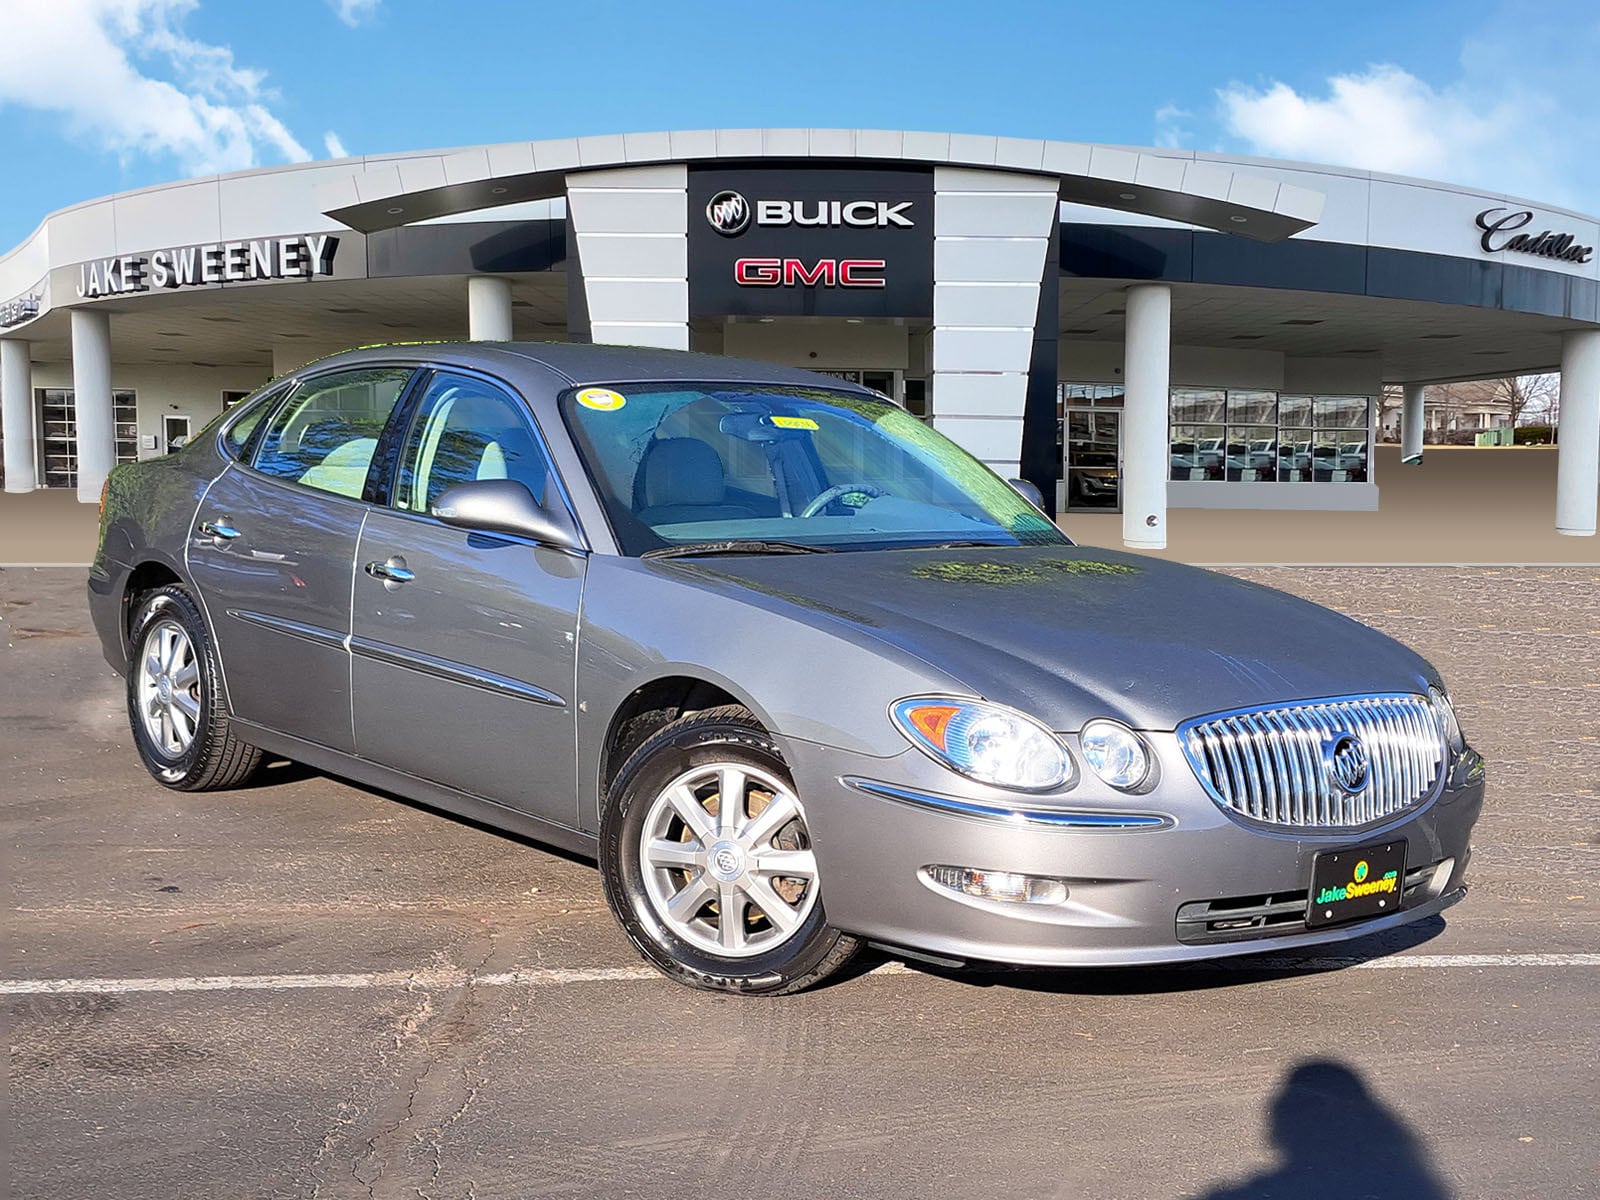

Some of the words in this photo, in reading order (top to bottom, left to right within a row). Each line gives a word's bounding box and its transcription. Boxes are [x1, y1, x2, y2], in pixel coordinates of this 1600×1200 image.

[757, 200, 915, 226] BUICK
[1475, 207, 1593, 264] Cadillac
[76, 255, 147, 298] JAKE
[151, 234, 338, 289] SWEENEY
[734, 257, 886, 287] GMC
